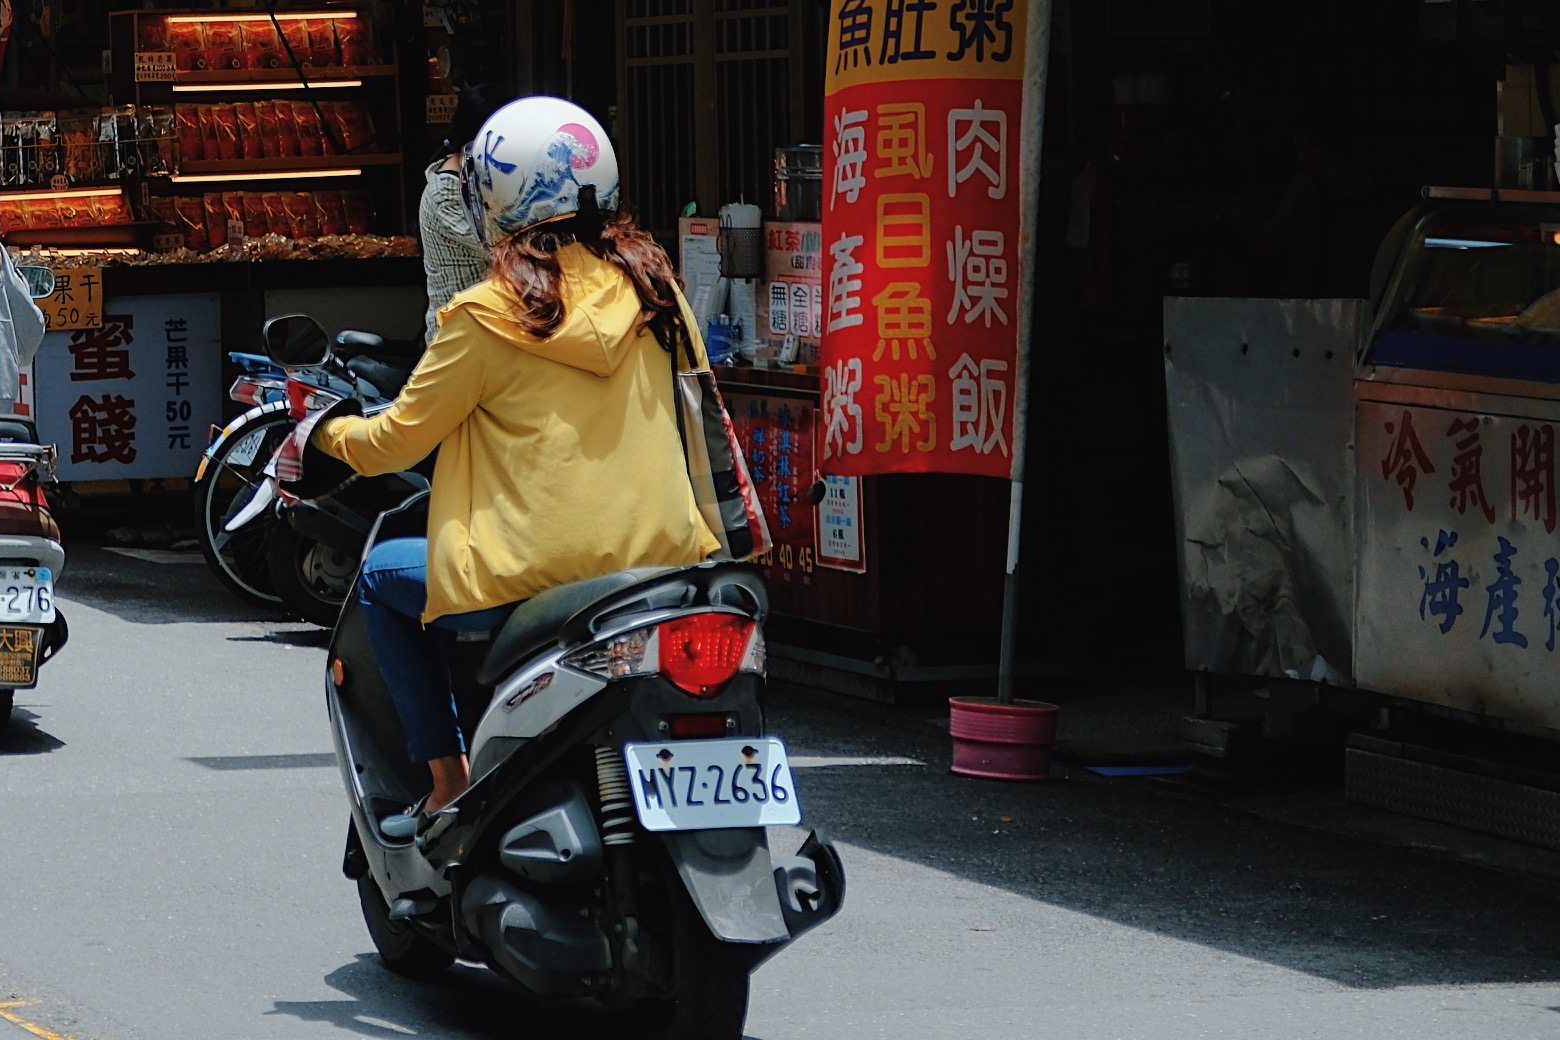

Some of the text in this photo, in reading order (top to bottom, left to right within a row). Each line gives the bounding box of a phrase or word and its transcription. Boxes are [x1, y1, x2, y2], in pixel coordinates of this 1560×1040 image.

[771, 284, 789, 331] 無糖
[793, 286, 809, 334] 全糖
[824, 106, 869, 456] 海產粥
[871, 101, 937, 454] 虱目魚粥
[945, 98, 1010, 455] 肉燥飯
[69, 313, 138, 465] 蜜餞
[1381, 409, 1557, 535] 冷氣開
[778, 543, 794, 571] 40
[798, 546, 814, 574] 45
